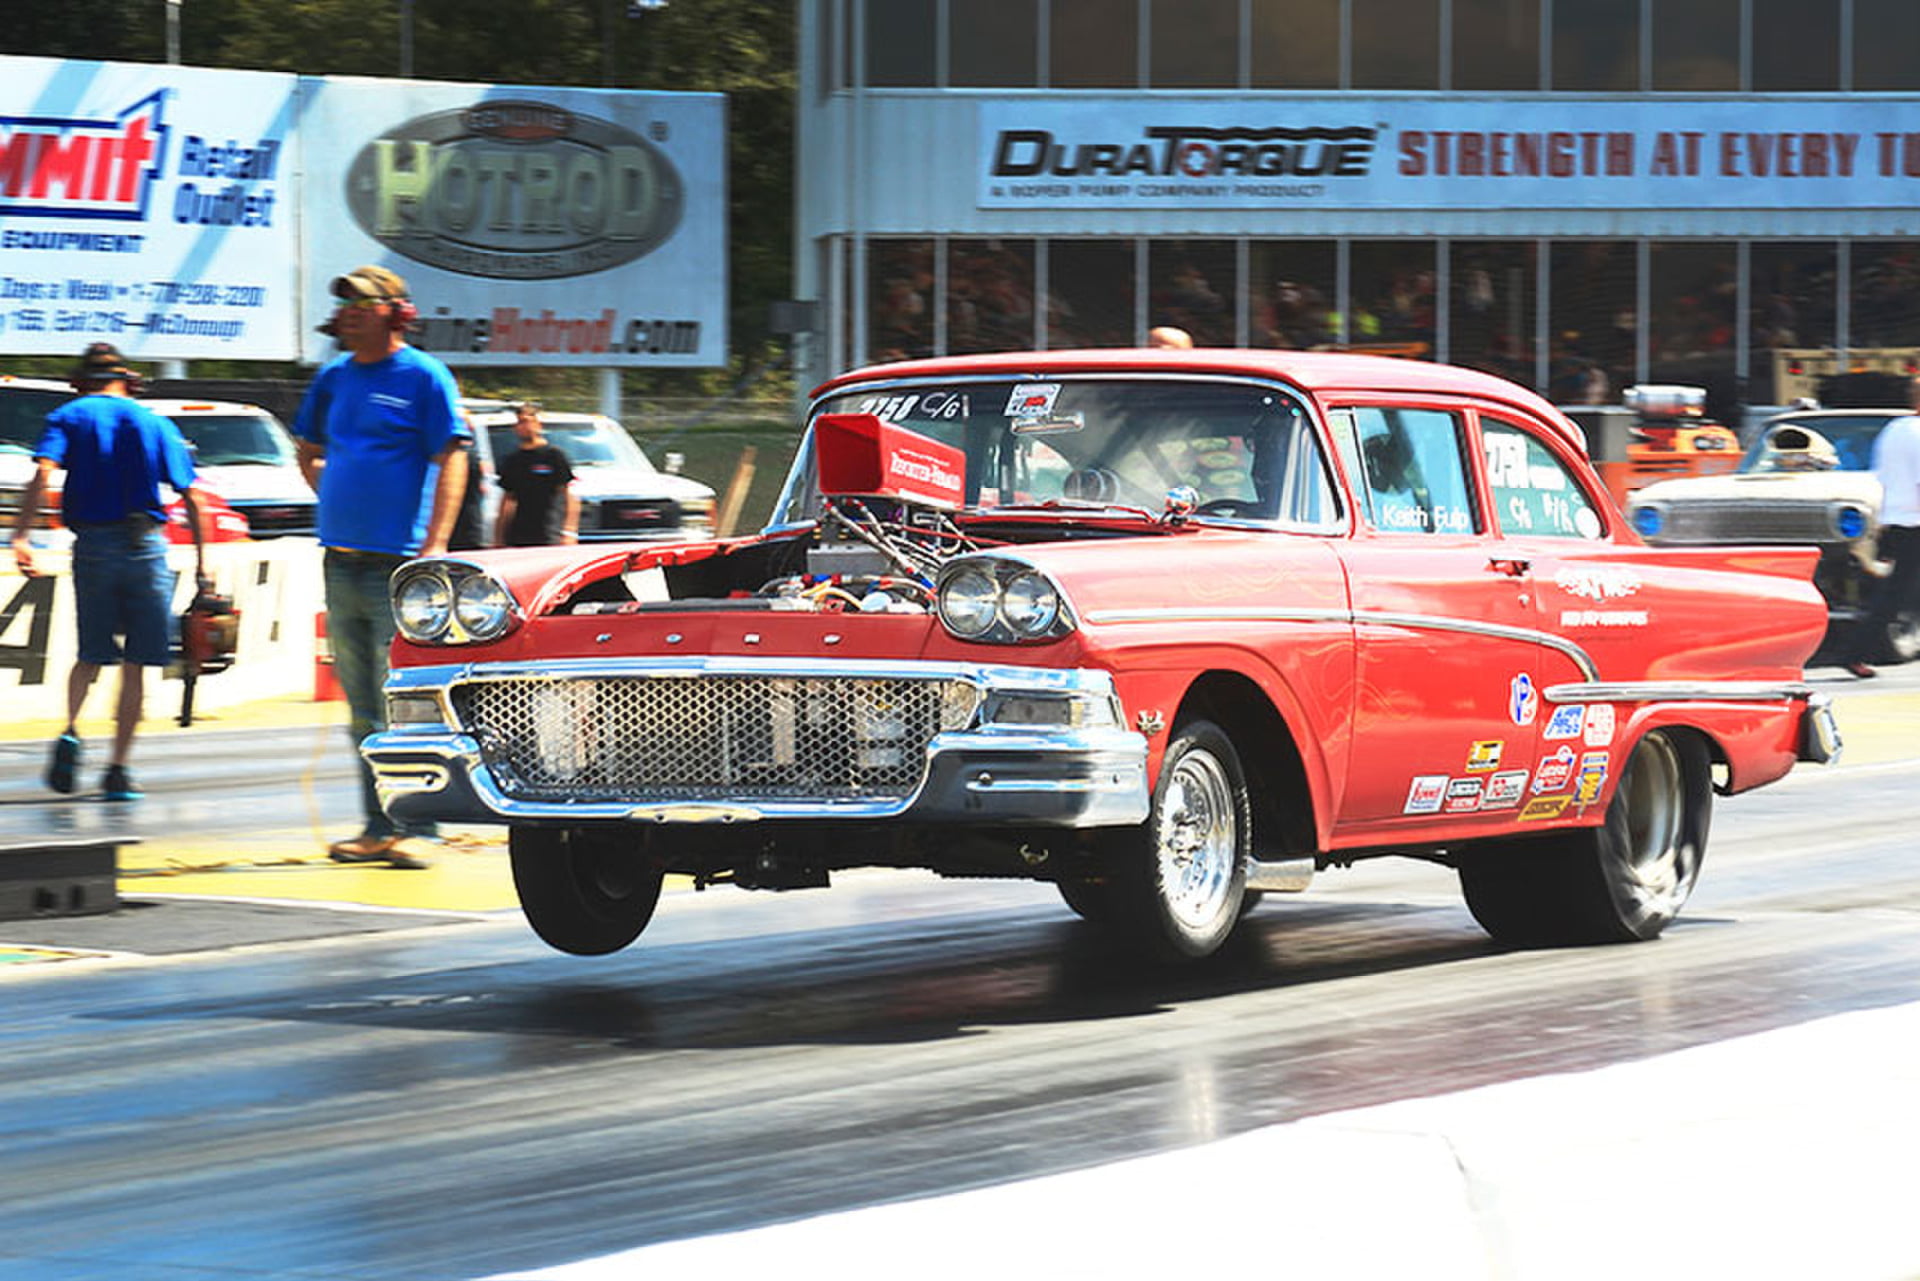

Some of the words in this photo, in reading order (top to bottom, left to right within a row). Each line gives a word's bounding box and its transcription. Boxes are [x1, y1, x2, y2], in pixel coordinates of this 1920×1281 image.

[1398, 131, 1636, 178] STRENGTH
[1650, 131, 1706, 178] AT
[1718, 132, 1861, 178] EVERY
[173, 181, 276, 227] Outlet
[373, 138, 656, 238] HOTROD
[1382, 505, 1429, 528] Keith
